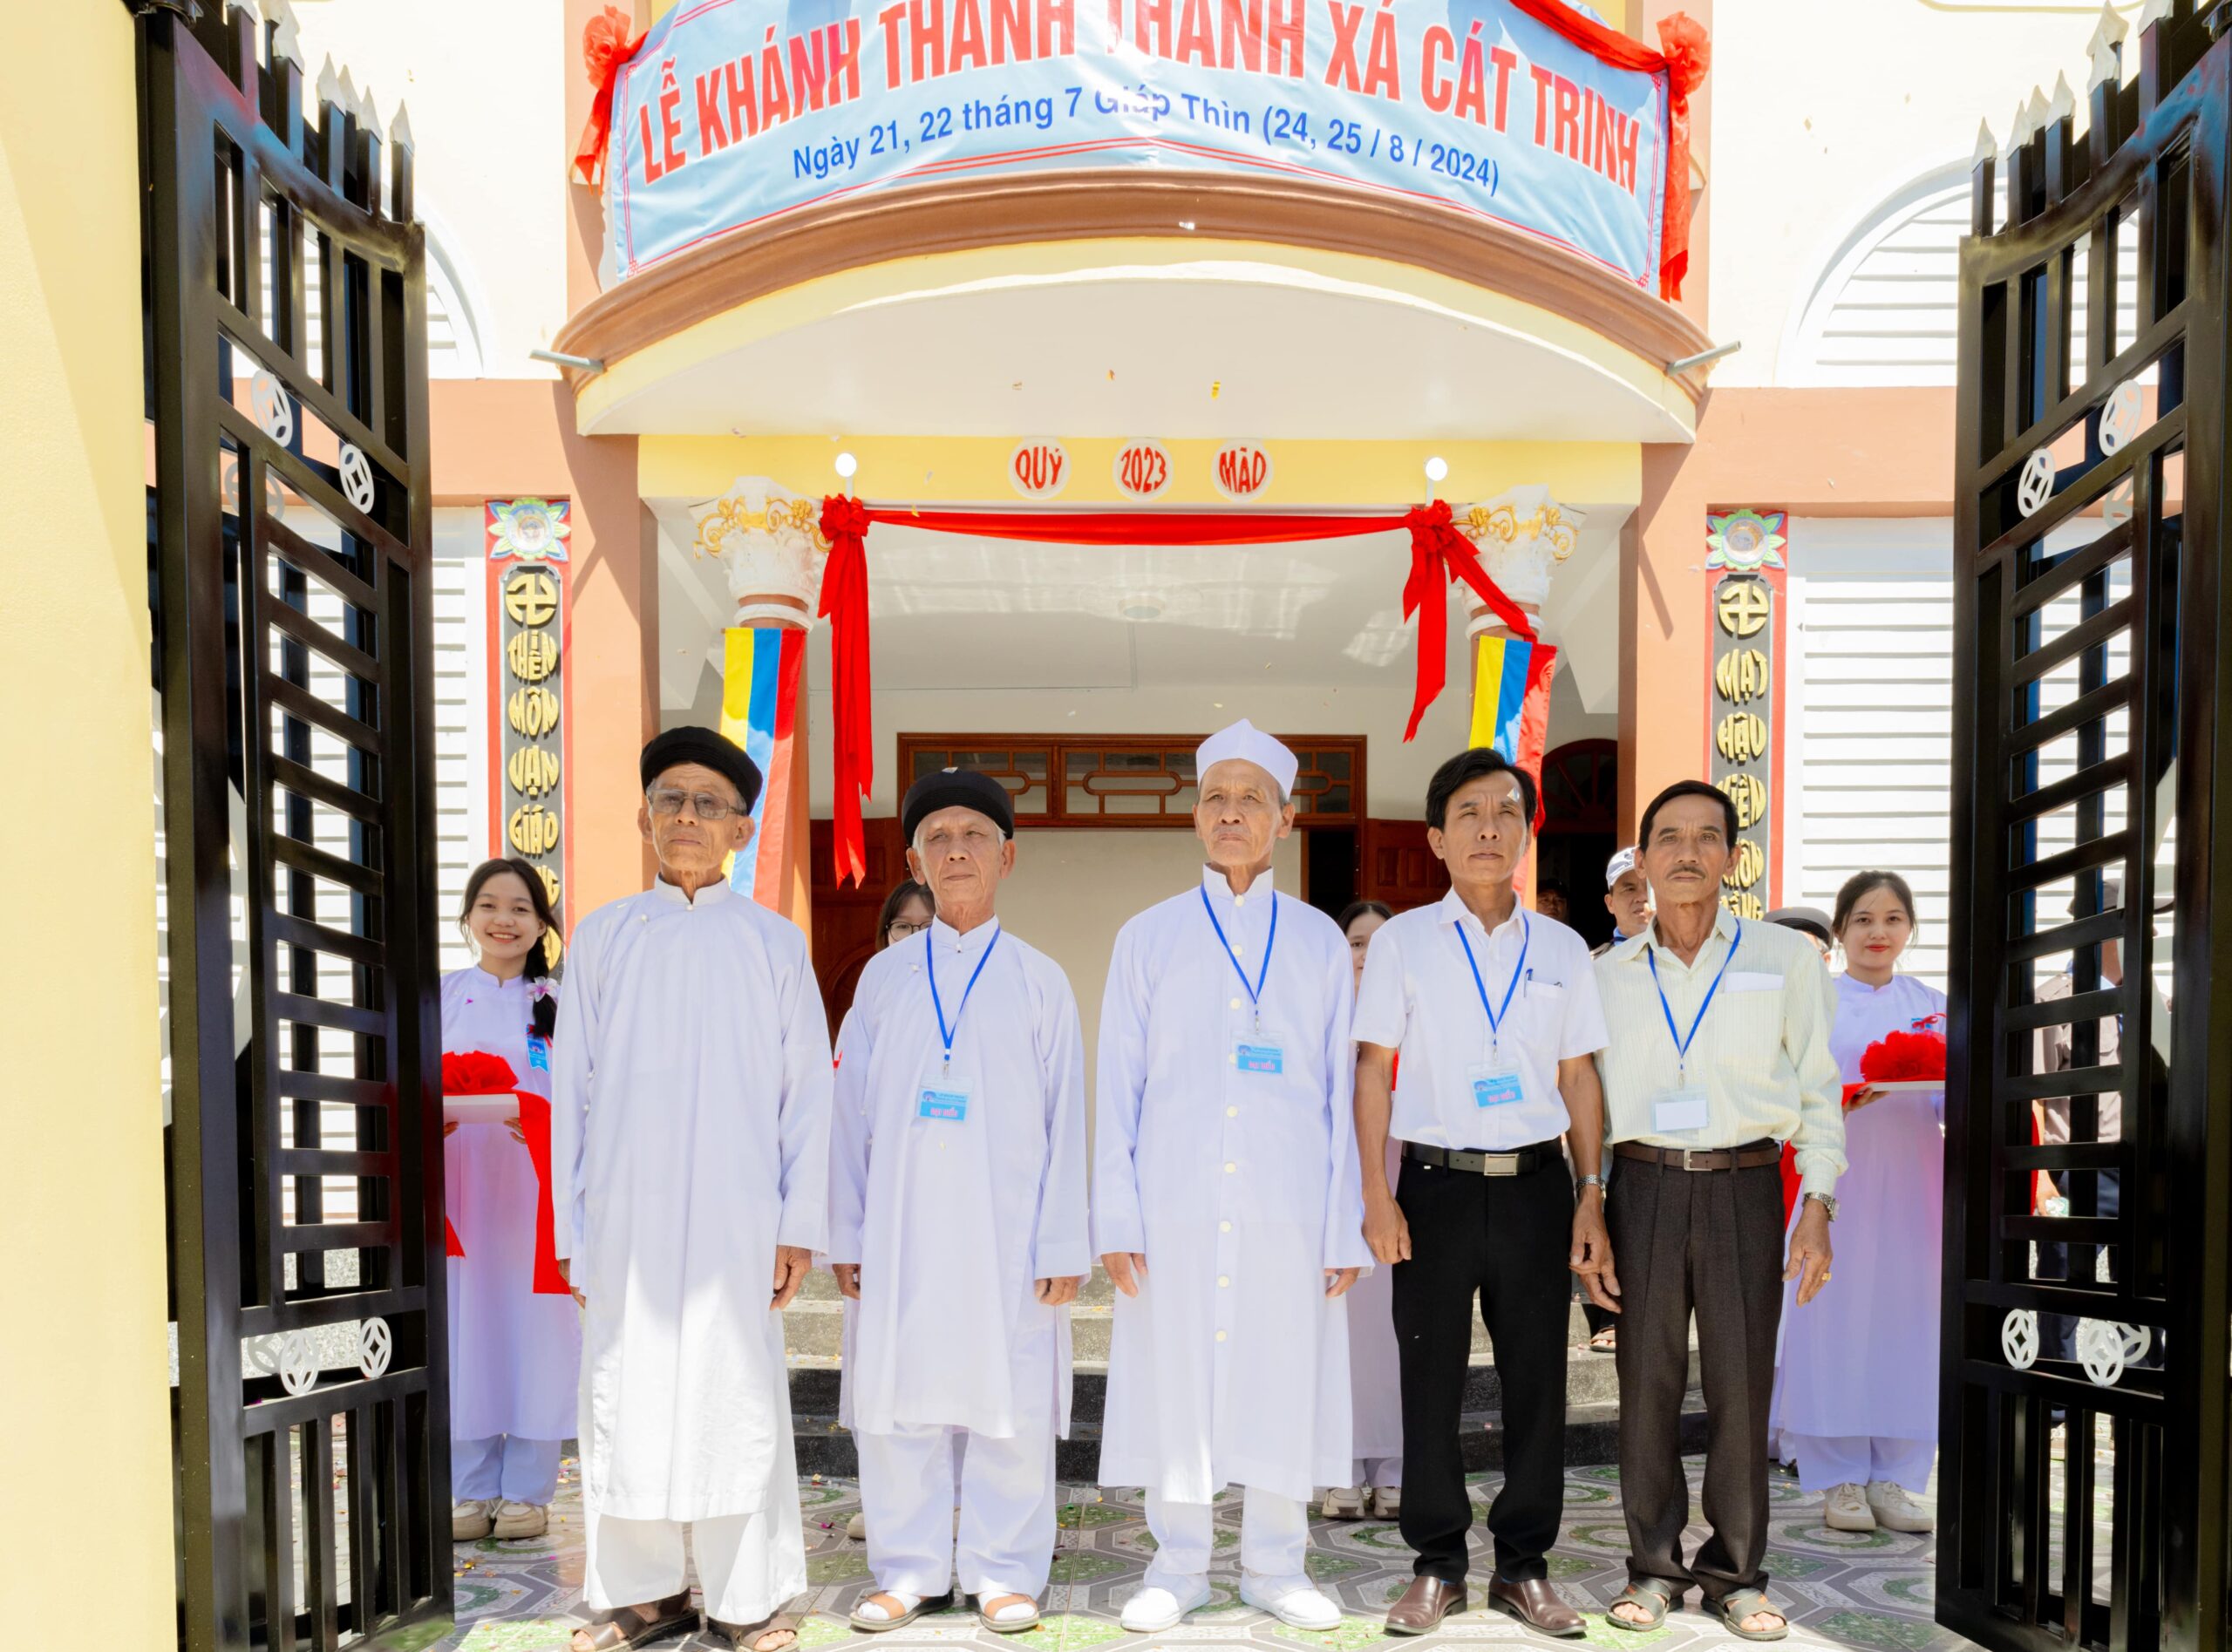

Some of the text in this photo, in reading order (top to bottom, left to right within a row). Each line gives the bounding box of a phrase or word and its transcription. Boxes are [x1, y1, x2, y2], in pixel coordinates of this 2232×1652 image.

[640, 56, 686, 185] LỄ
[695, 24, 861, 157] KHÁNH
[1421, 21, 1517, 133] CÁT
[1531, 63, 1640, 196] TRINH
[793, 137, 860, 179] Ngày
[870, 120, 910, 154] 21,
[920, 107, 953, 142] 22
[963, 95, 1052, 129] tháng
[1065, 87, 1083, 117] 7
[1095, 84, 1171, 121] Giáp
[1181, 93, 1249, 133] Thìn
[1263, 105, 1316, 149] (24,
[1431, 144, 1499, 197] 2024)
[1015, 446, 1062, 489] QUÝ
[1121, 447, 1167, 493] 2023
[1716, 649, 1767, 702] MẠT
[508, 686, 558, 736] MÔN
[1717, 711, 1766, 761] HẬU
[508, 745, 559, 795] VẠN
[508, 805, 559, 854] GIÁO
